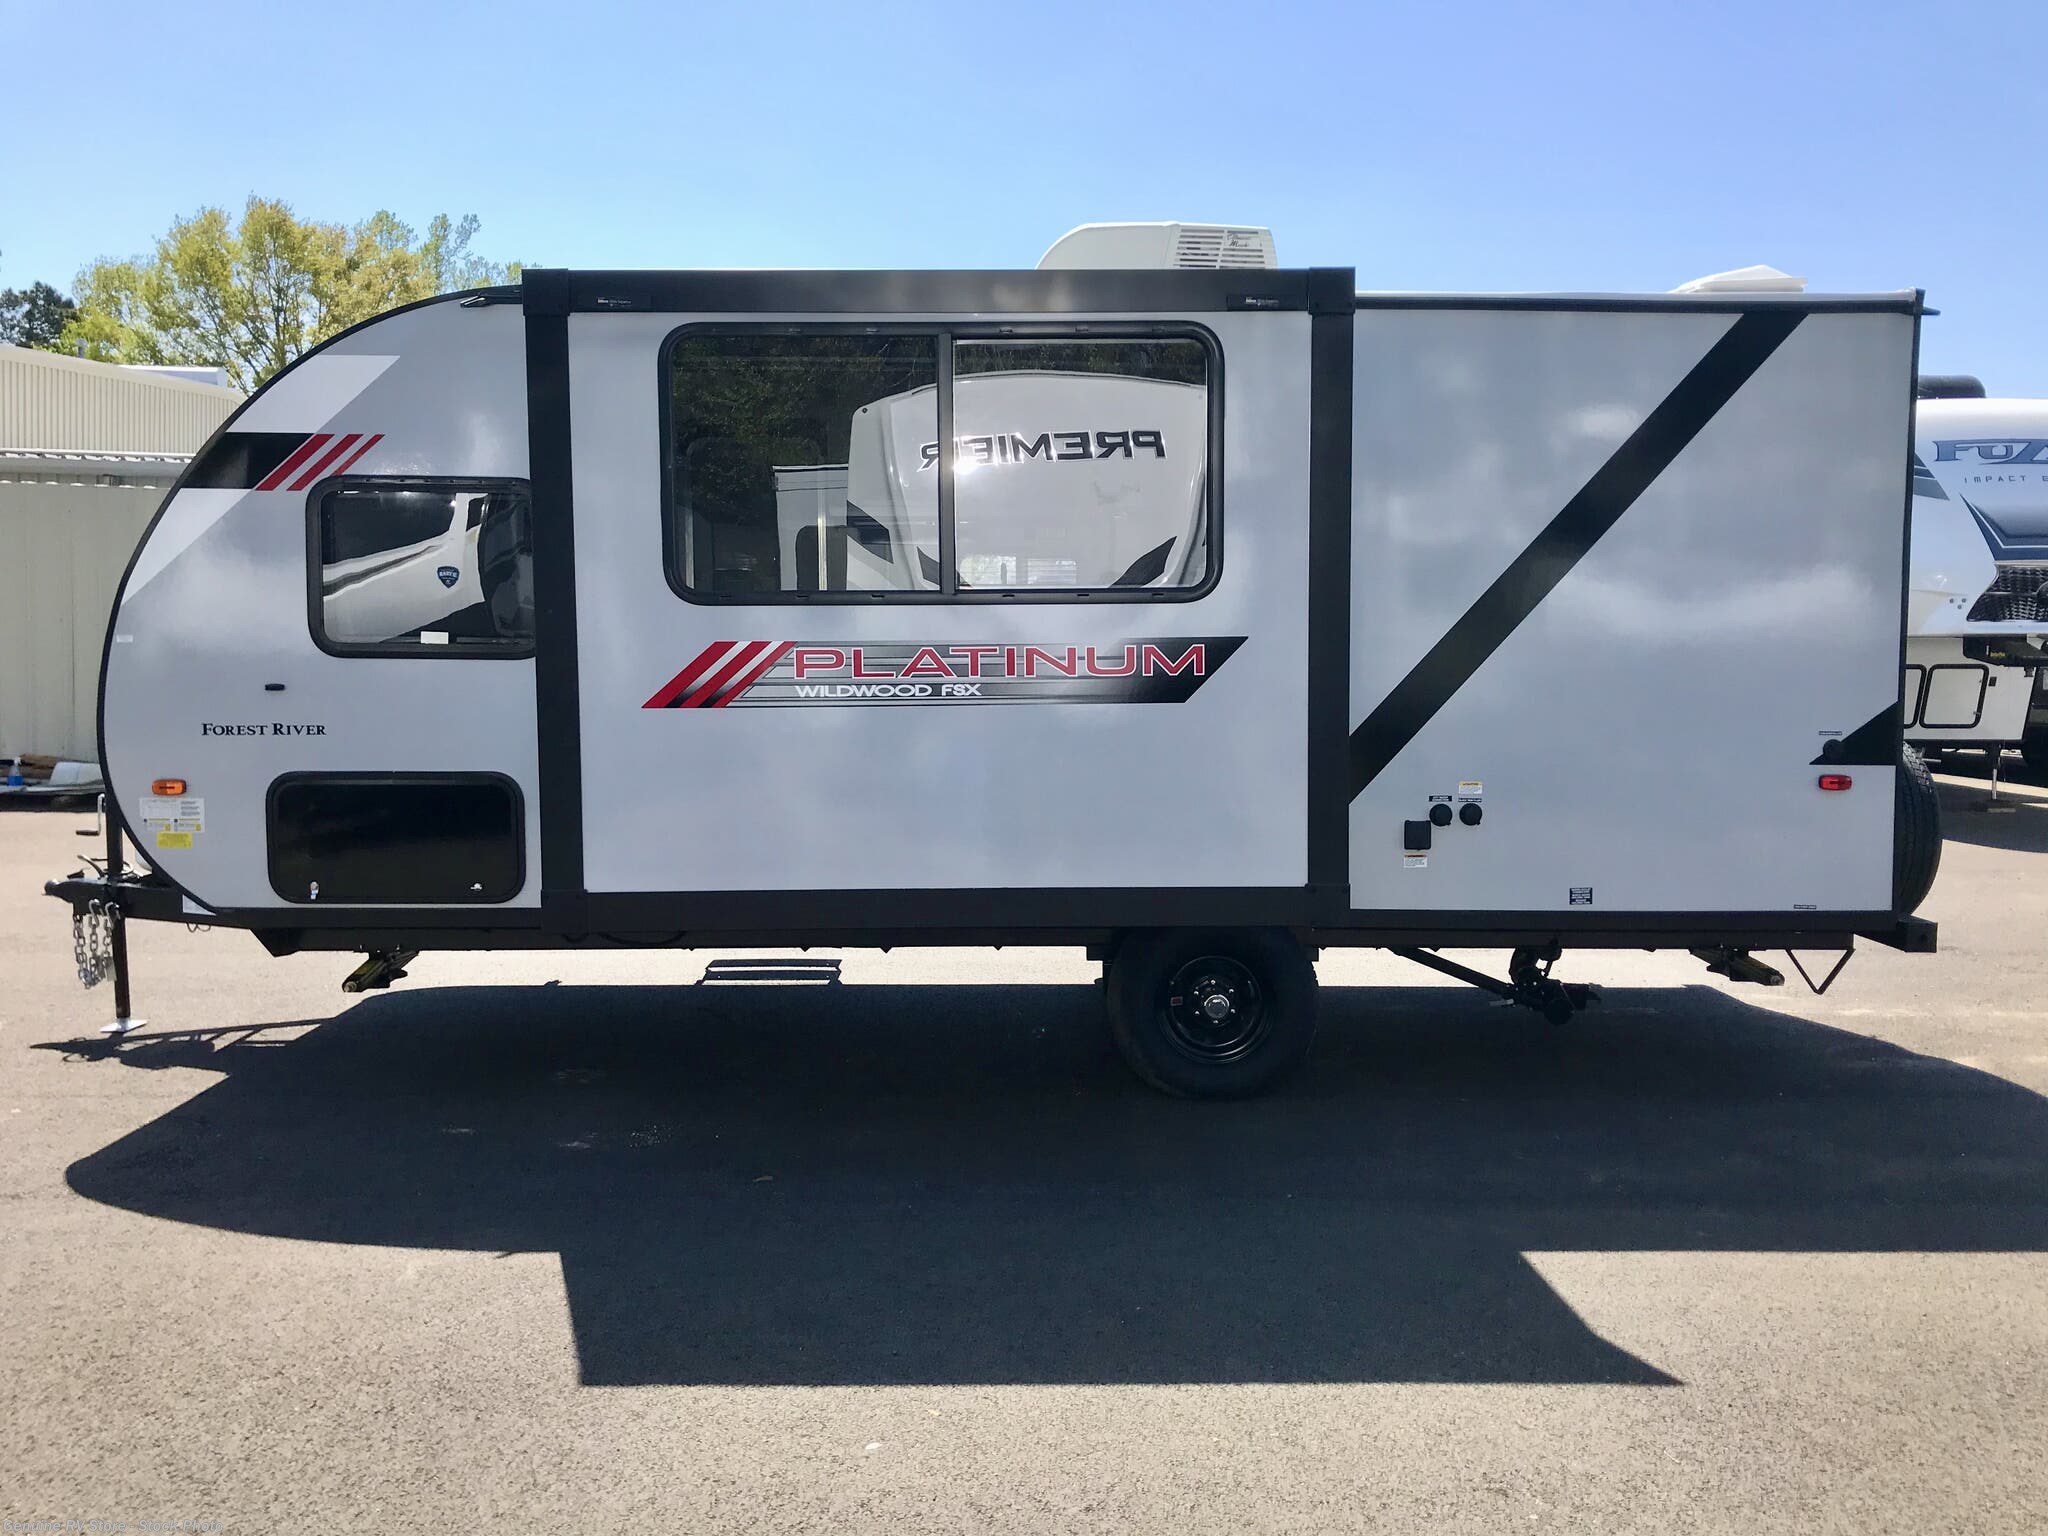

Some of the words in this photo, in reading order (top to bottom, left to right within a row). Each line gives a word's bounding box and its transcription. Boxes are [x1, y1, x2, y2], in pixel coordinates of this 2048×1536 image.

[1964, 474, 2026, 483] IMPACT
[793, 644, 1206, 680] PLATINUM
[795, 683, 933, 698] WILDWOOD
[941, 683, 982, 697] FSX
[201, 722, 268, 736] FOREST
[271, 722, 327, 736] RIVER
